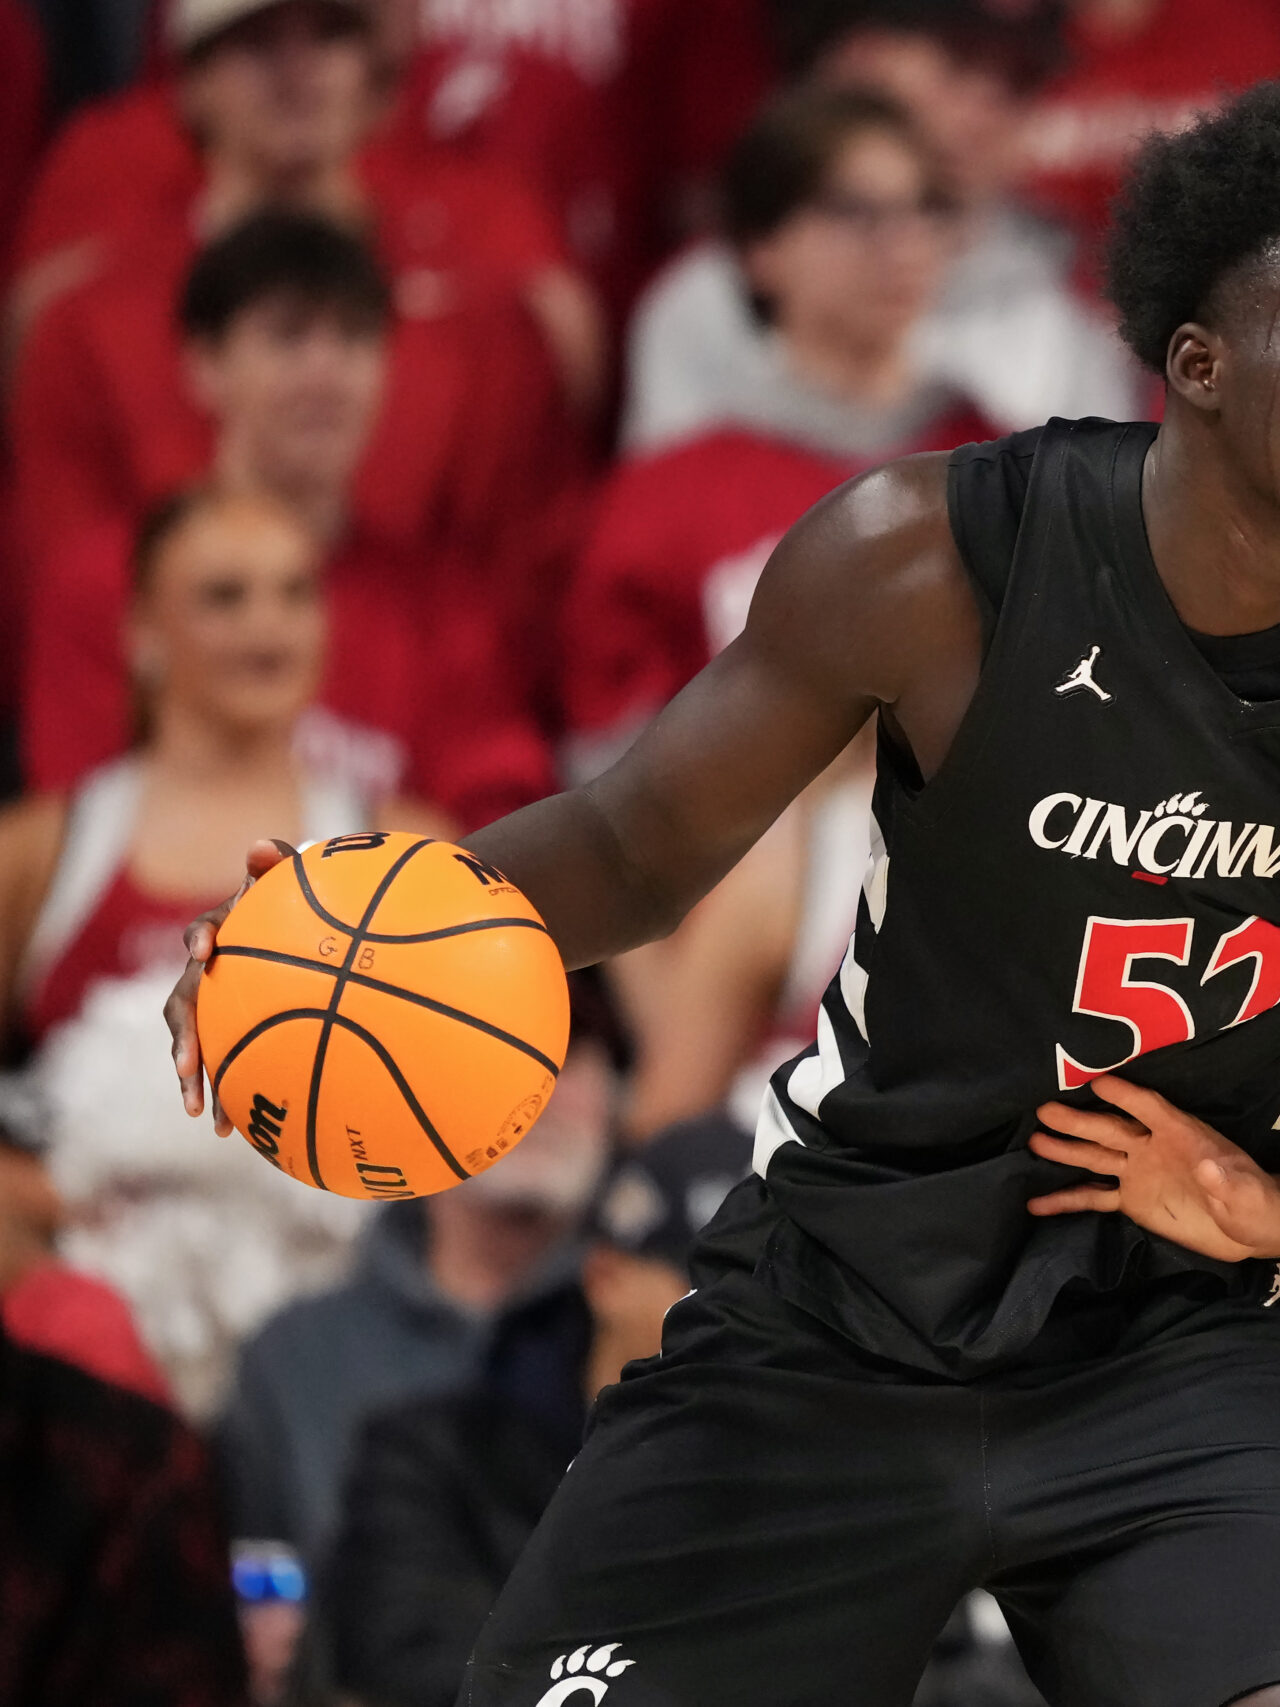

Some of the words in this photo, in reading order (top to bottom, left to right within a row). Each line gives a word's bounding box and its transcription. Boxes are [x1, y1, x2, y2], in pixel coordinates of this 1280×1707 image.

[358, 947, 376, 970] B
[248, 1093, 288, 1170] on
[346, 1124, 369, 1162] NXT
